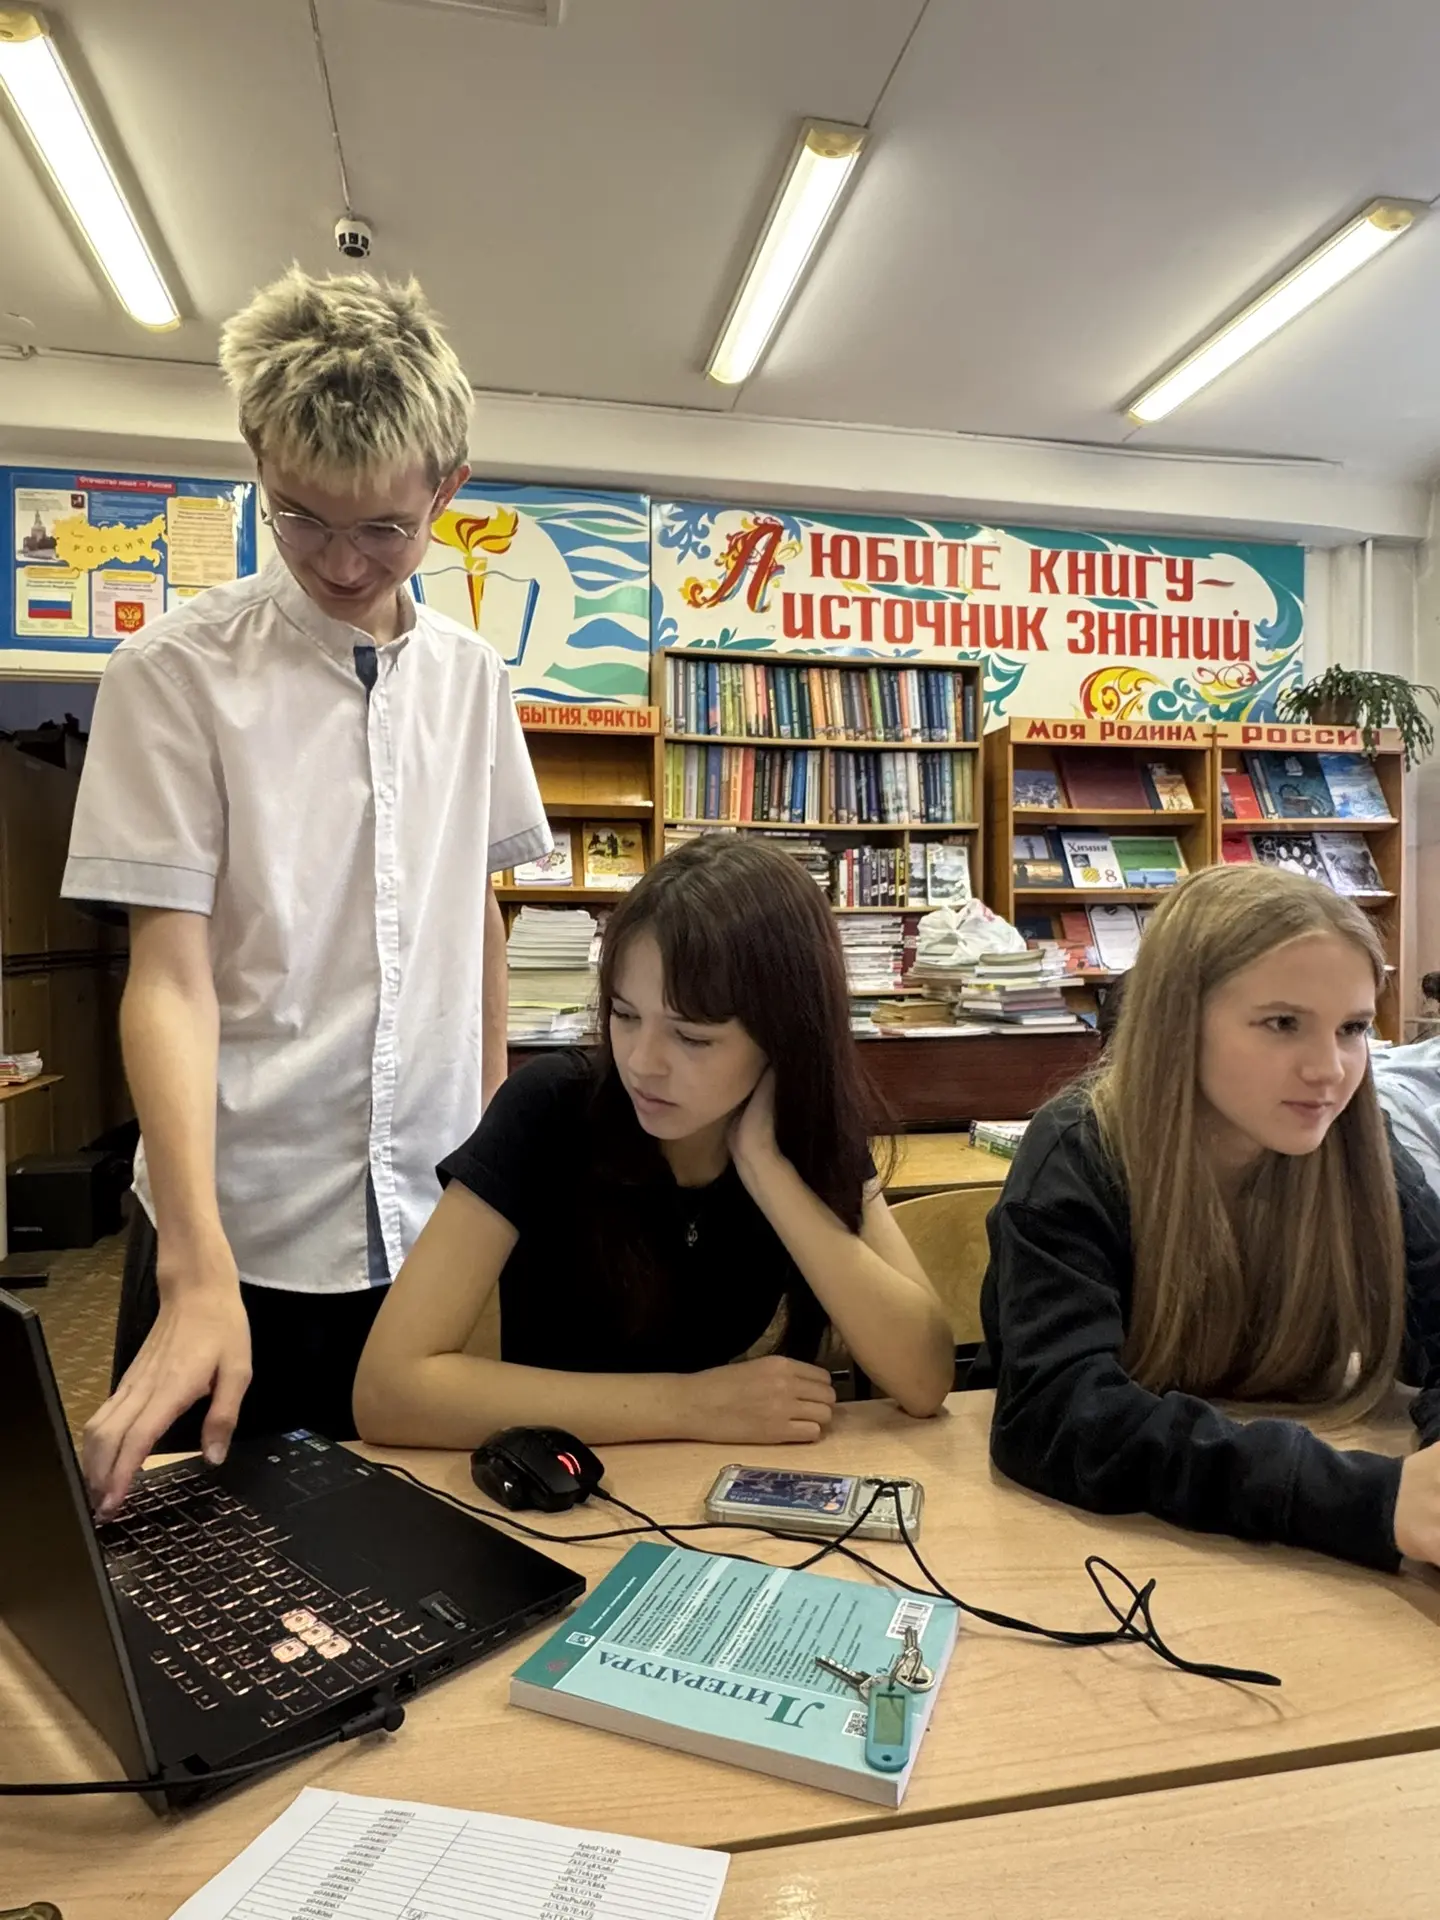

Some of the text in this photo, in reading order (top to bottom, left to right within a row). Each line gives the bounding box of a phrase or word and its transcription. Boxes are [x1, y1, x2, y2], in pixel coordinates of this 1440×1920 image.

[73, 537, 146, 554] РОССИЯ
[688, 517, 1002, 613] ЛЮБИТЕ
[782, 592, 1251, 662] ИСТОЧНИК ЗНАНИЙ
[1067, 842, 1108, 852] Химия
[1105, 870, 1117, 883] 8
